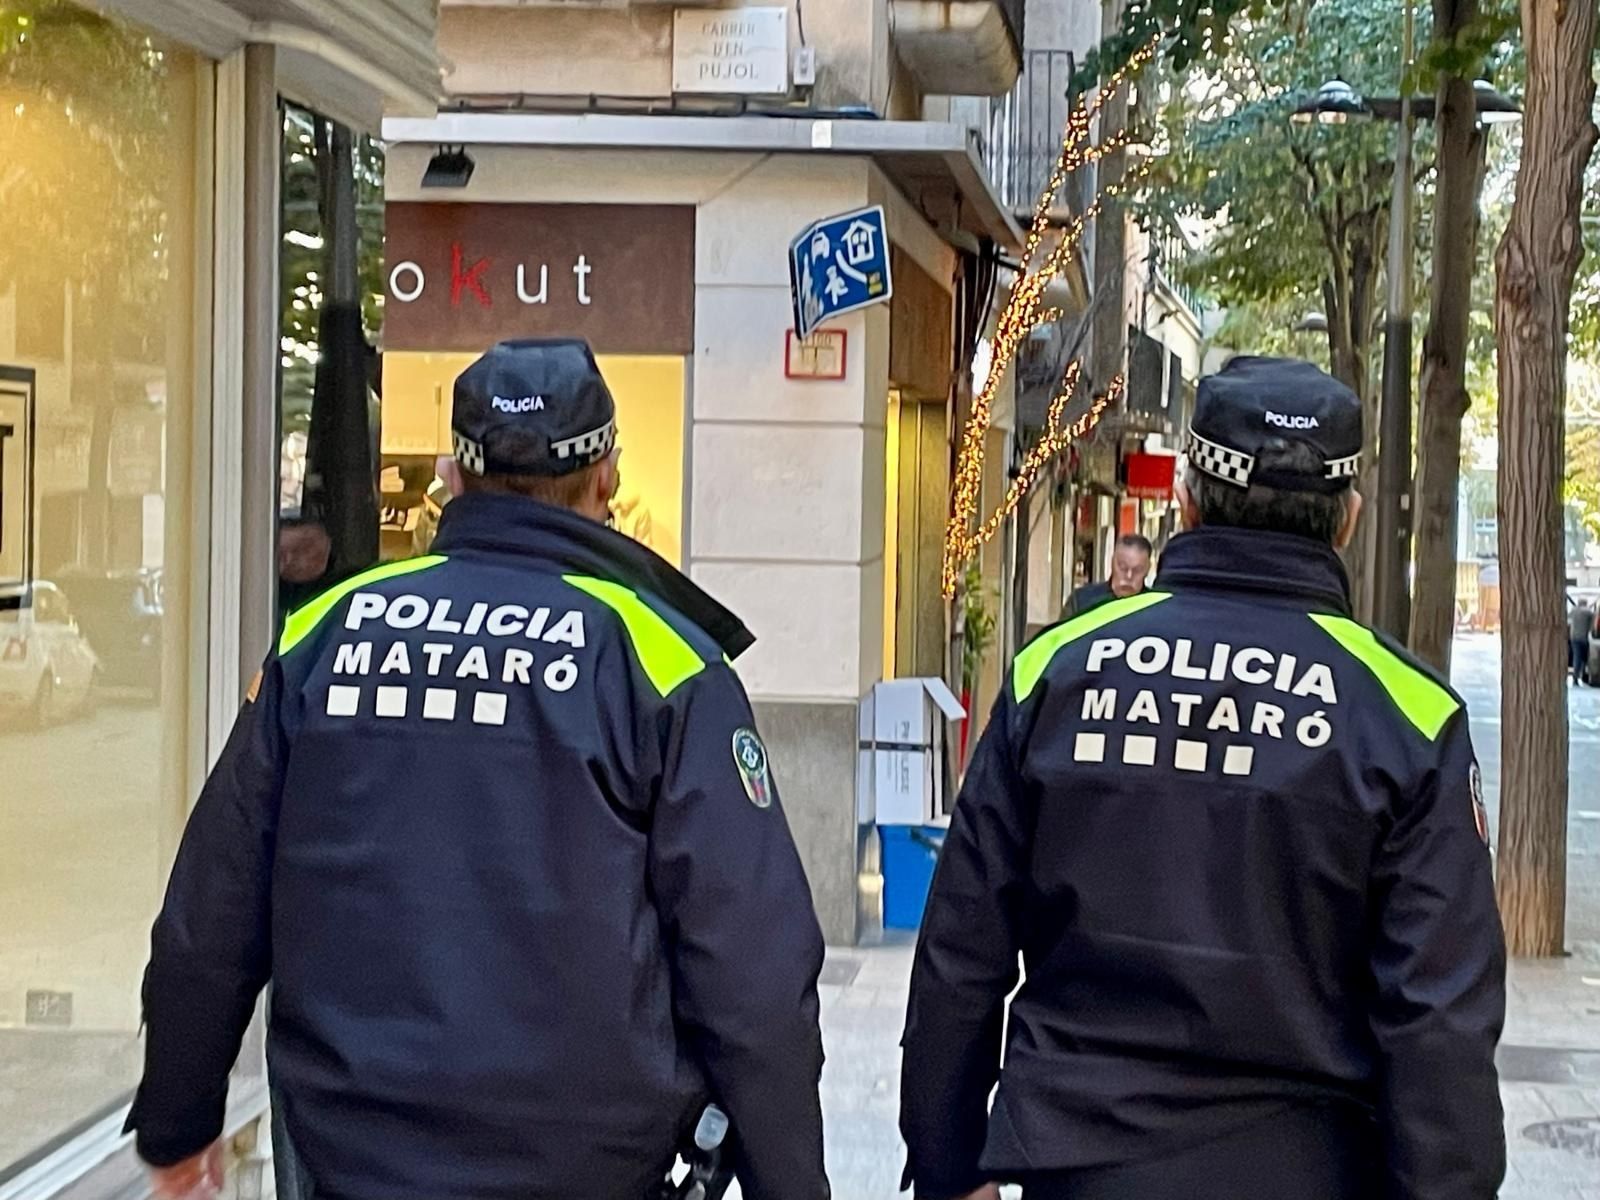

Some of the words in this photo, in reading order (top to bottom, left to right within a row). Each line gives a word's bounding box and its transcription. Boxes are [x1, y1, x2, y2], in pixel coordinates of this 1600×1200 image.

[699, 62, 759, 80] PUJOL
[491, 395, 545, 413] POLICIA
[1264, 410, 1320, 429] POLICIA
[344, 592, 586, 648] POLICIA
[332, 641, 579, 692] MATARÓ
[1085, 636, 1338, 704] POLICIA
[1081, 688, 1332, 748] MATARÓ
